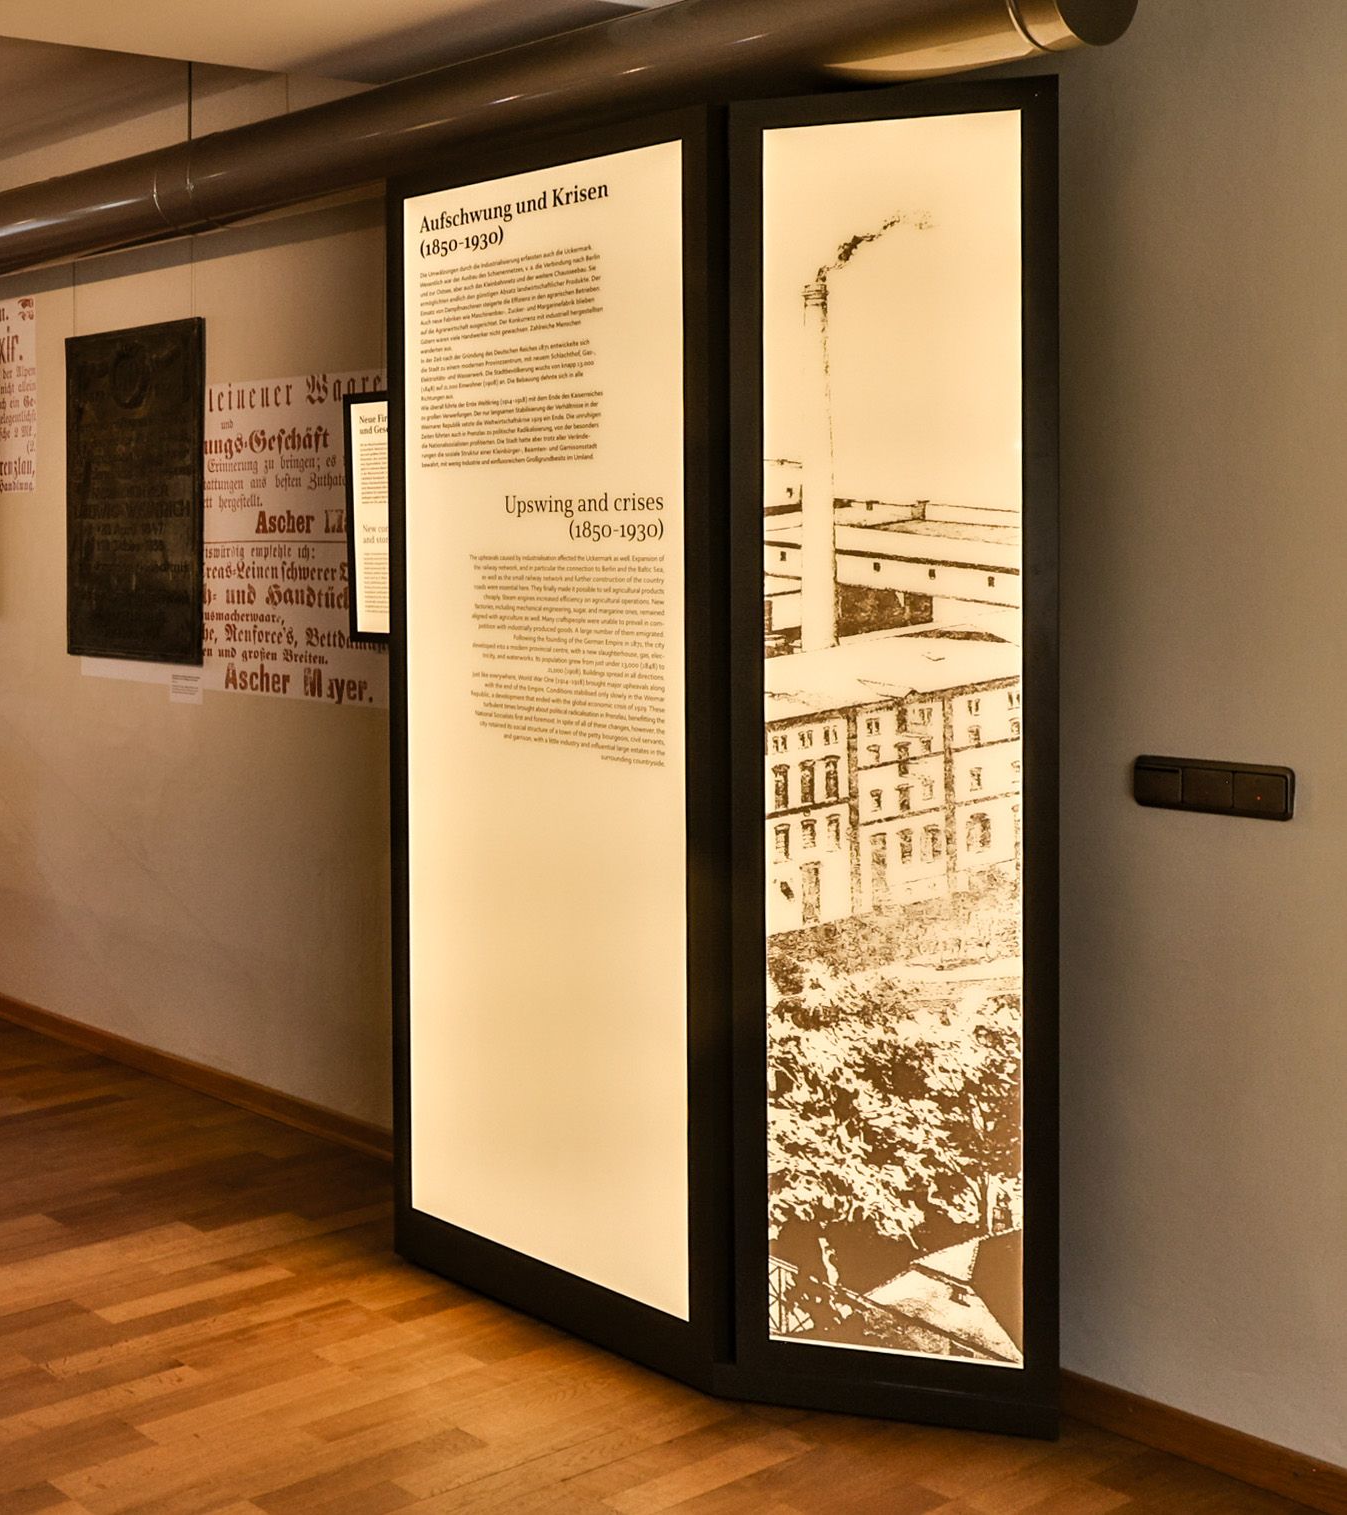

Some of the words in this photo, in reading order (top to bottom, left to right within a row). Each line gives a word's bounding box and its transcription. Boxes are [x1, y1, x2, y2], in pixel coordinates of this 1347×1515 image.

[419, 204, 512, 234] Aufschwung
[516, 191, 547, 215] und
[552, 182, 609, 208] Krisen
[419, 225, 504, 260] (1850-1930)
[209, 383, 292, 412] leinener
[359, 415, 376, 424] Neue
[359, 425, 373, 435] und
[264, 459, 274, 474] zu
[505, 495, 574, 518] Upswing
[578, 493, 609, 512] and
[614, 493, 664, 511] crises
[255, 509, 315, 534] Ascher
[363, 524, 376, 533] New
[569, 518, 664, 542] (1850-1930)
[363, 536, 375, 544] and
[226, 583, 256, 605] und
[218, 647, 237, 658] und
[224, 663, 290, 694] Ascher
[304, 667, 373, 705] Mayer.
